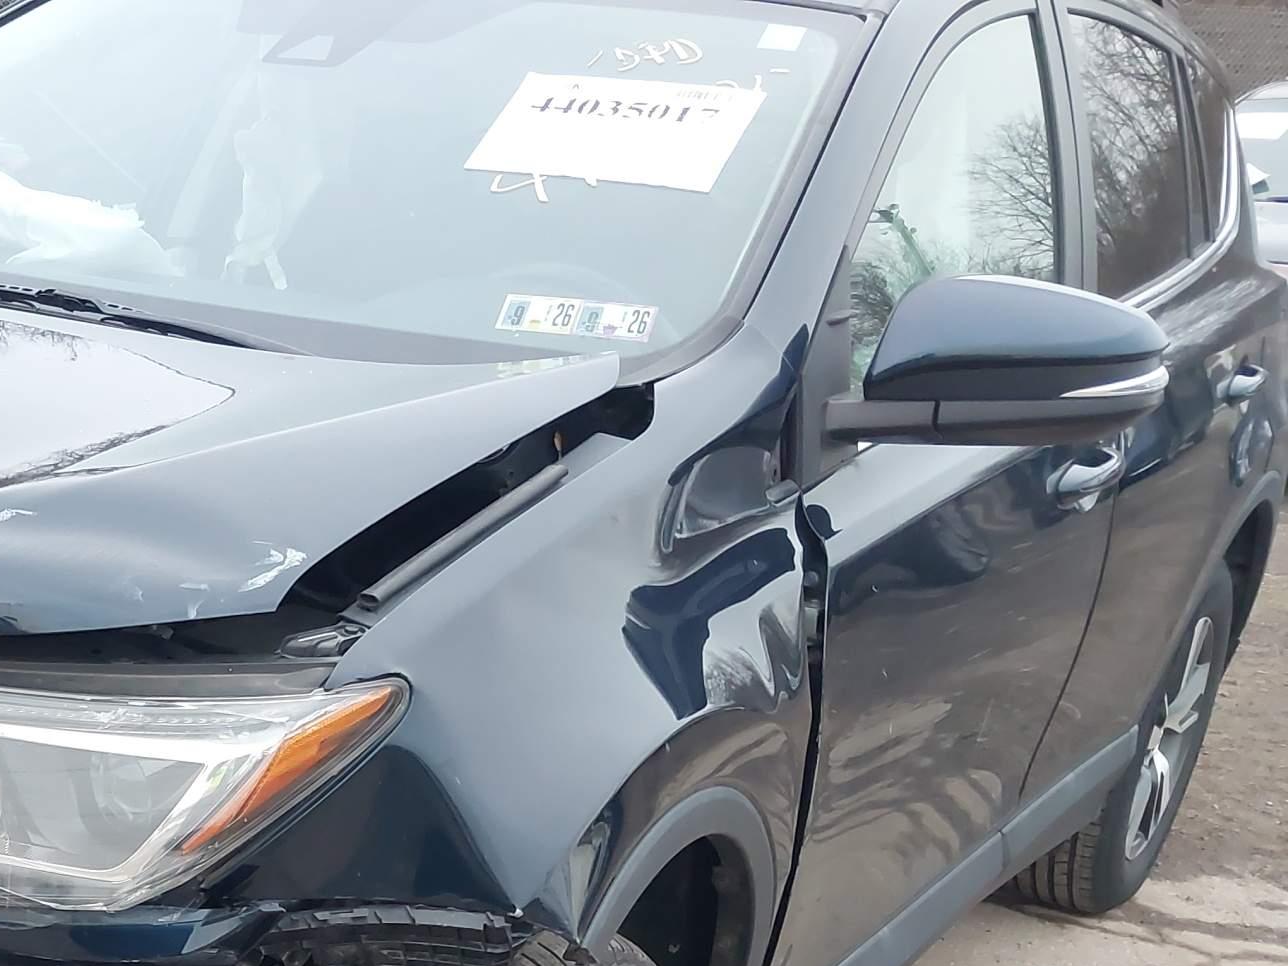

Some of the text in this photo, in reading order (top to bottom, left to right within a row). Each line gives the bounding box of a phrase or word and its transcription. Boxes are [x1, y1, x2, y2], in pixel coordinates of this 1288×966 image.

[511, 305, 526, 326] 9
[552, 303, 575, 327] 26
[627, 309, 650, 334] 26
